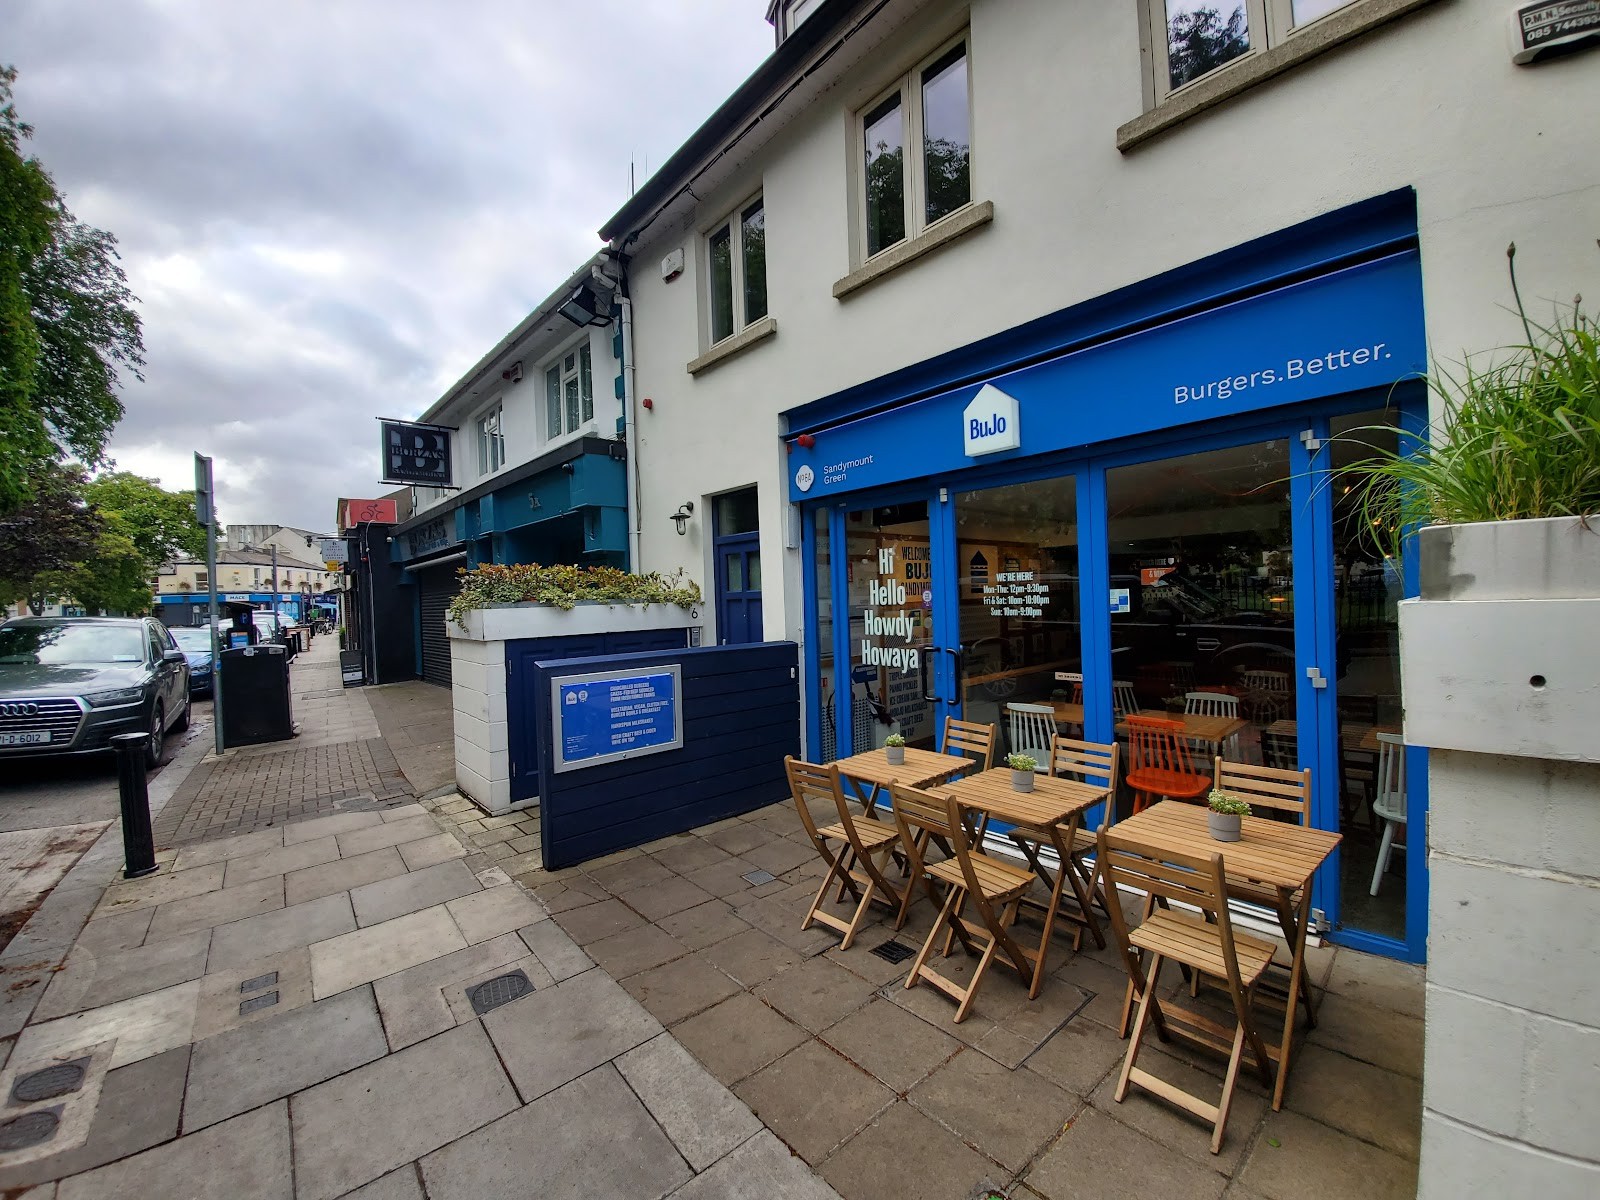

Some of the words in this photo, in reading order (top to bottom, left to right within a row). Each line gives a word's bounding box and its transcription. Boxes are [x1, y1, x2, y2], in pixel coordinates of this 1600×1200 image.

[1526, 26, 1551, 41] 085
[970, 413, 1007, 440] BuJo
[823, 454, 874, 474] Sandymount
[823, 473, 847, 484] Green
[879, 547, 894, 575] Hi
[905, 563, 931, 579] BUJ
[996, 572, 1016, 582] WE'RE
[1016, 571, 1034, 581] HERE
[869, 579, 906, 606] Hello
[991, 596, 996, 604] &
[240, 612, 249, 625] P
[691, 607, 699, 619] 6
[864, 610, 914, 643] Howdy
[861, 639, 919, 674] Howaya
[0, 734, 41, 744] 1-D-6012
